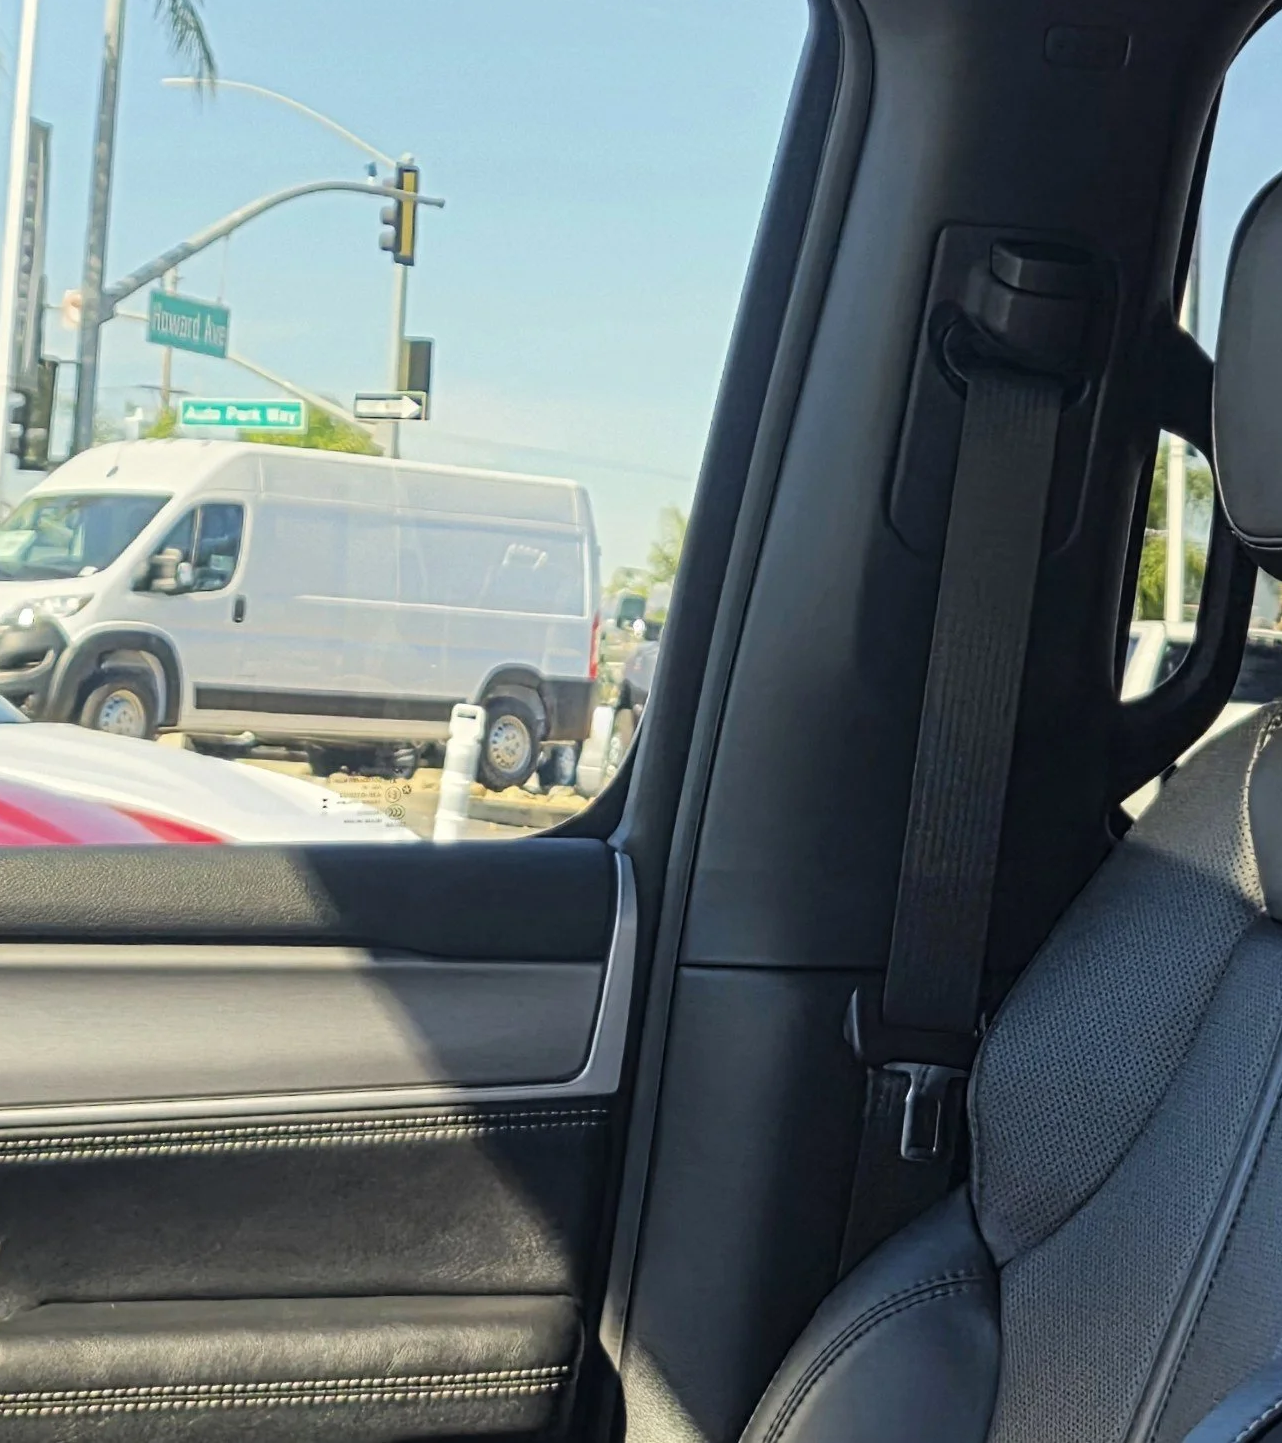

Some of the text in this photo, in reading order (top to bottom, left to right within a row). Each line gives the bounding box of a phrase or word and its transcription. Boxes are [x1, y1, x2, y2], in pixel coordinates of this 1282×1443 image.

[152, 302, 228, 347] Howard Ave
[184, 405, 296, 425] Auto Park Way
